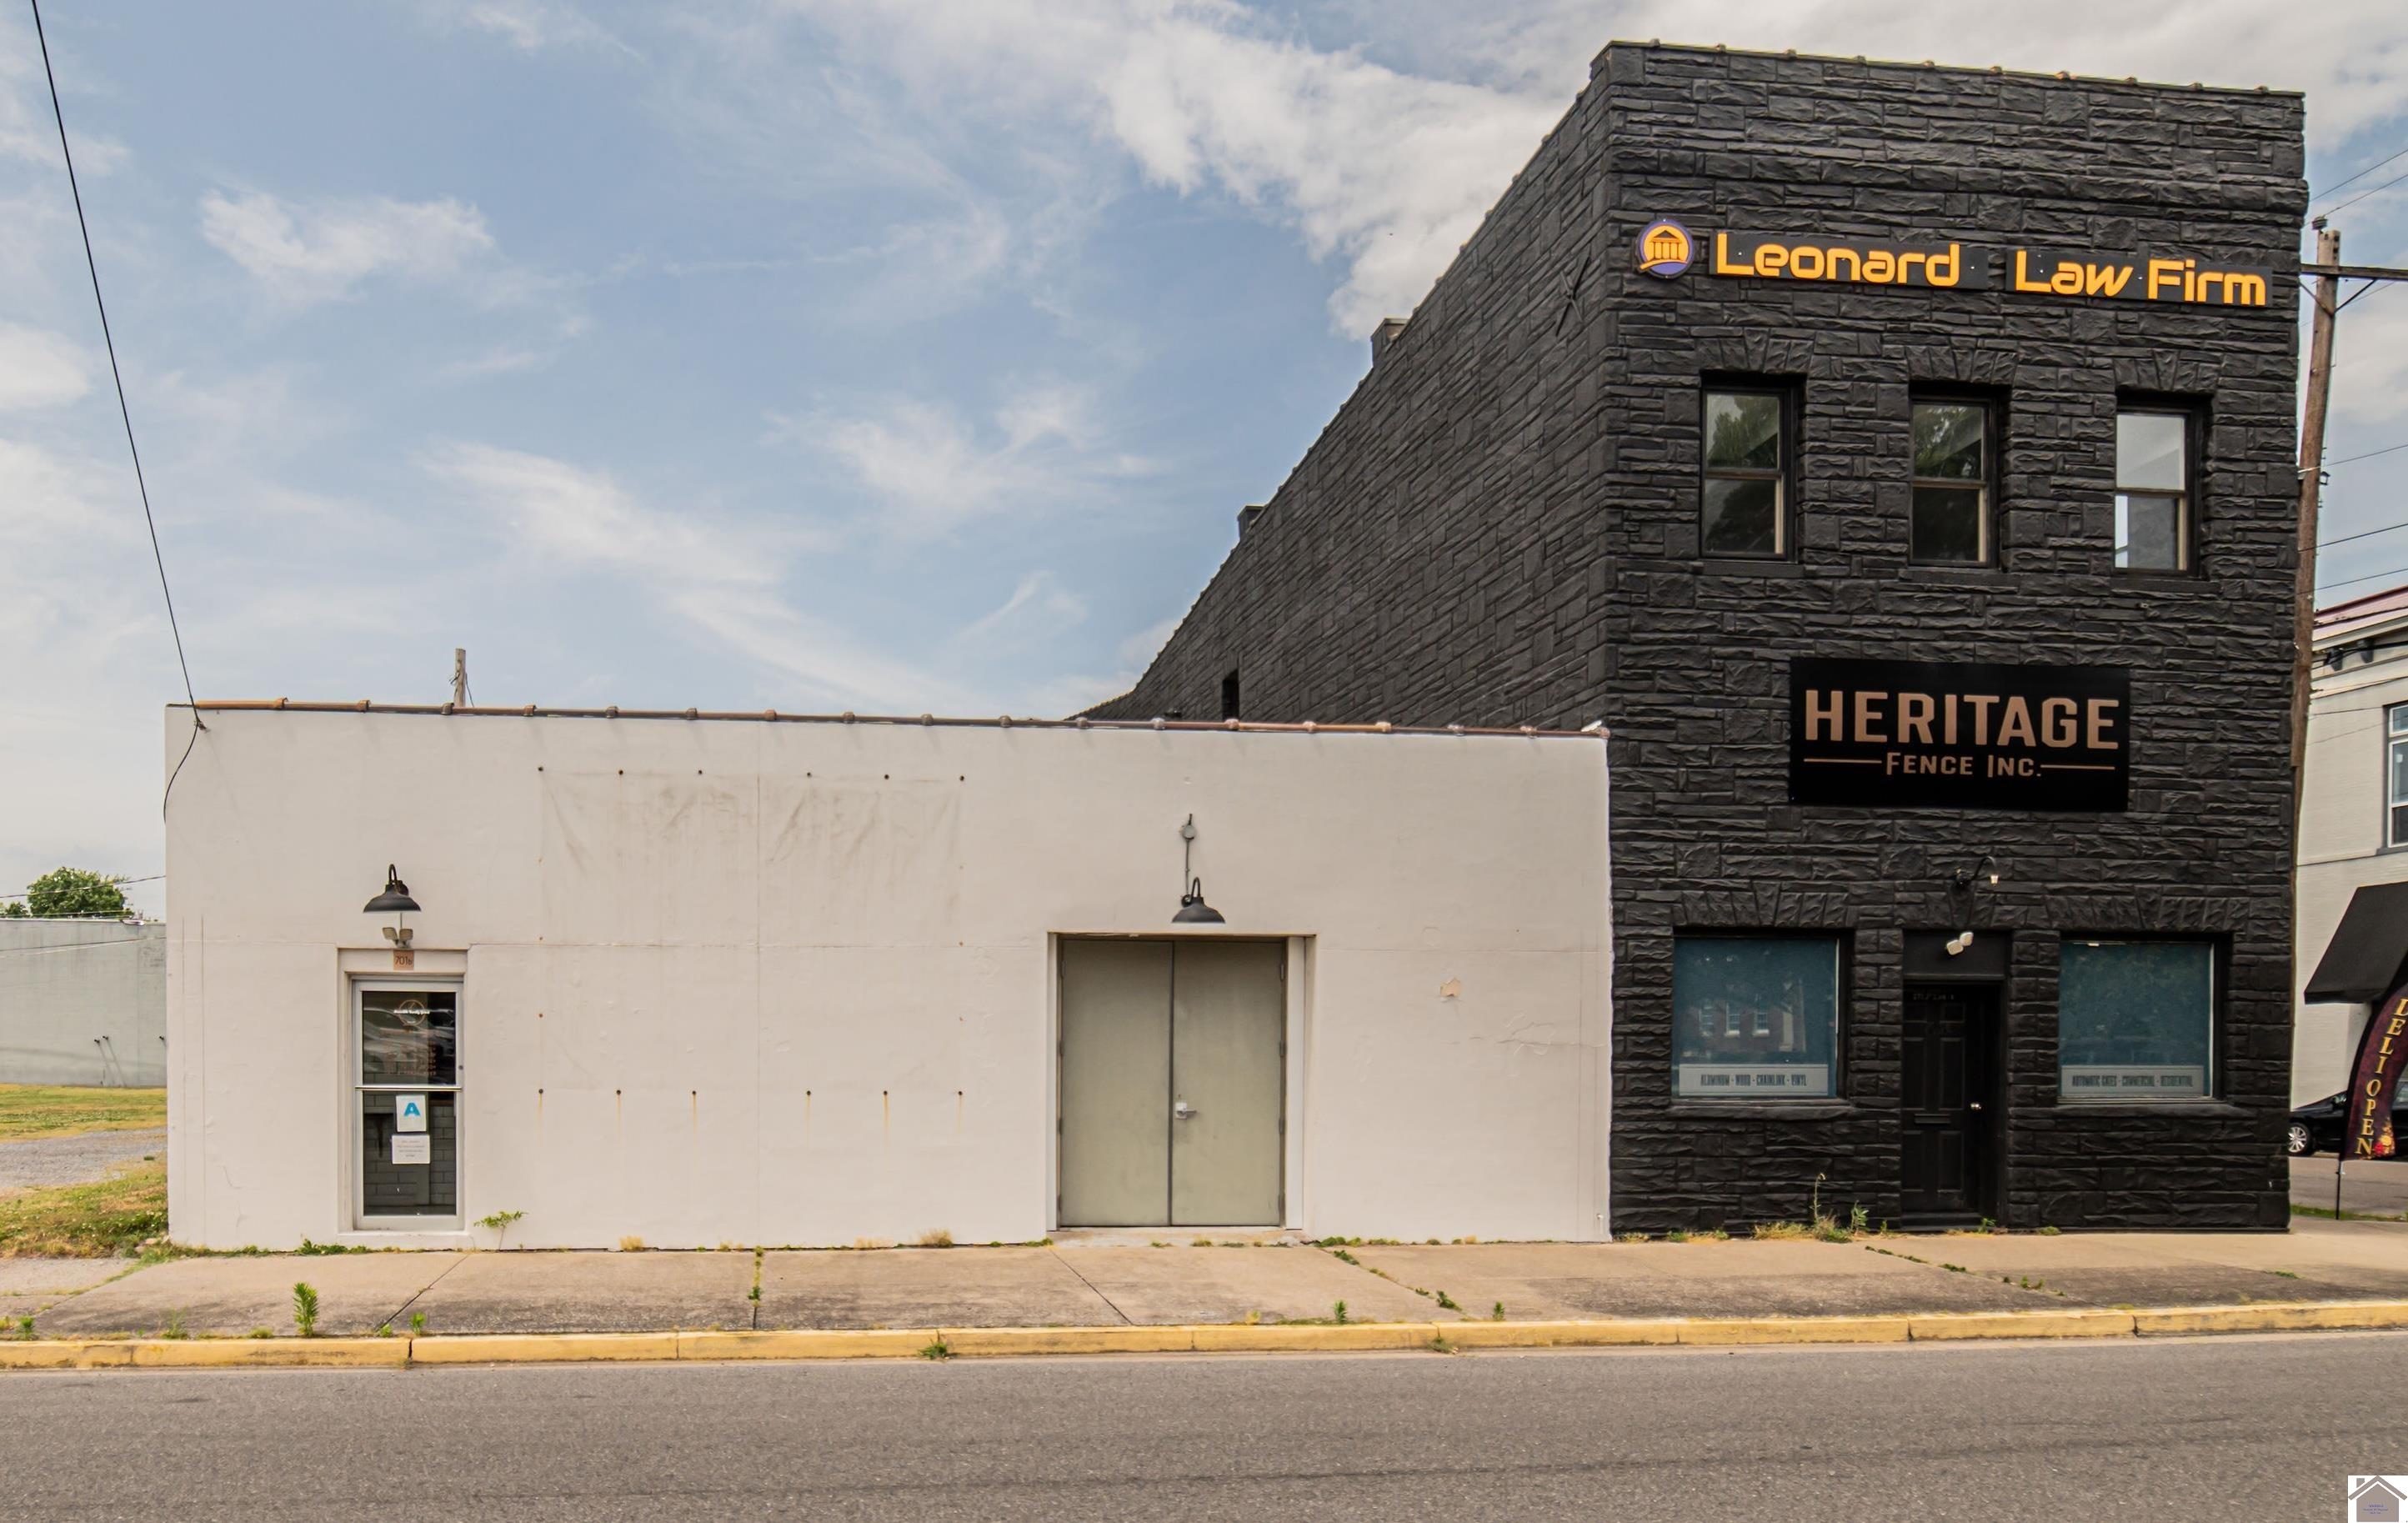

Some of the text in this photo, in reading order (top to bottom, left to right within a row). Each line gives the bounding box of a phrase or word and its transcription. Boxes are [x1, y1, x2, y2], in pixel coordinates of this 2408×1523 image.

[1716, 233, 2266, 306] Leonard Law Firm
[1805, 689, 2120, 749] HERITAGE
[1886, 752, 2042, 778] FENCE INC.
[2355, 998, 2408, 1155] DELI OPEN
[403, 1102, 421, 1116] A
